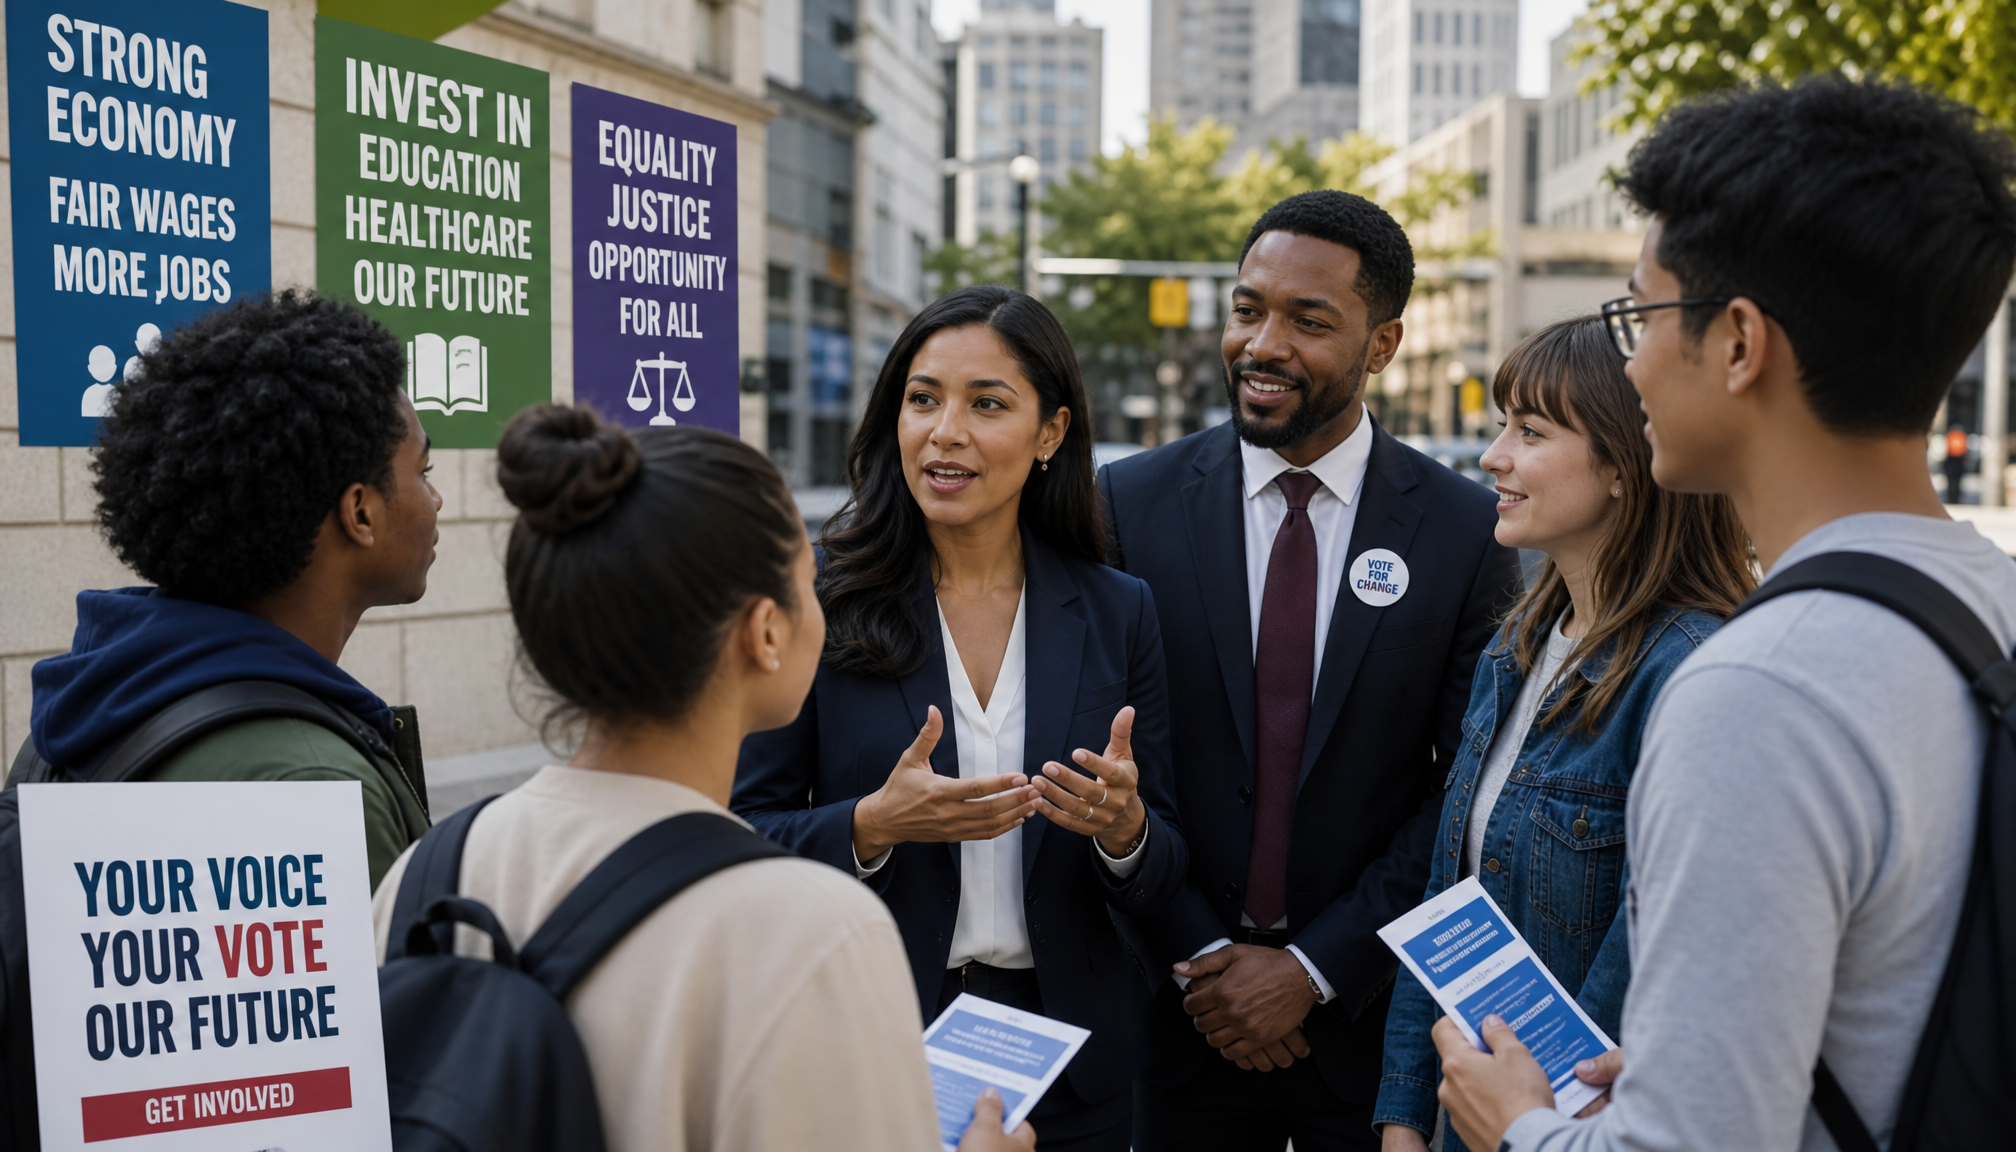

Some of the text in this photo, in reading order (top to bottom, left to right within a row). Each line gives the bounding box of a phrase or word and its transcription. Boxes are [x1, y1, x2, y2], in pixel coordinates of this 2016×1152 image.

[48, 14, 207, 98] STRONG
[48, 86, 236, 167] ECONOMY
[347, 57, 530, 148] INVEST IN
[360, 133, 520, 202] EDUCATION
[599, 120, 716, 186] EQUALITY
[50, 177, 235, 241] FAIR WAGES
[346, 195, 532, 259] HEALTHCARE
[608, 184, 711, 239] JUSTICE
[54, 244, 231, 304] MORE JOBS
[354, 260, 529, 315] OUR FUTURE
[589, 240, 726, 291] OPPORTUNITY
[621, 297, 702, 338] FOR ALL
[1357, 579, 1399, 595] CHANGE
[1367, 558, 1394, 572] VOTE
[1368, 570, 1388, 582] FOR
[74, 854, 326, 917] YOUR VOICE
[81, 919, 327, 988] YOUR VOTE
[86, 985, 339, 1061] OUR FUTURE
[146, 1083, 294, 1124] GET INVOLVED
